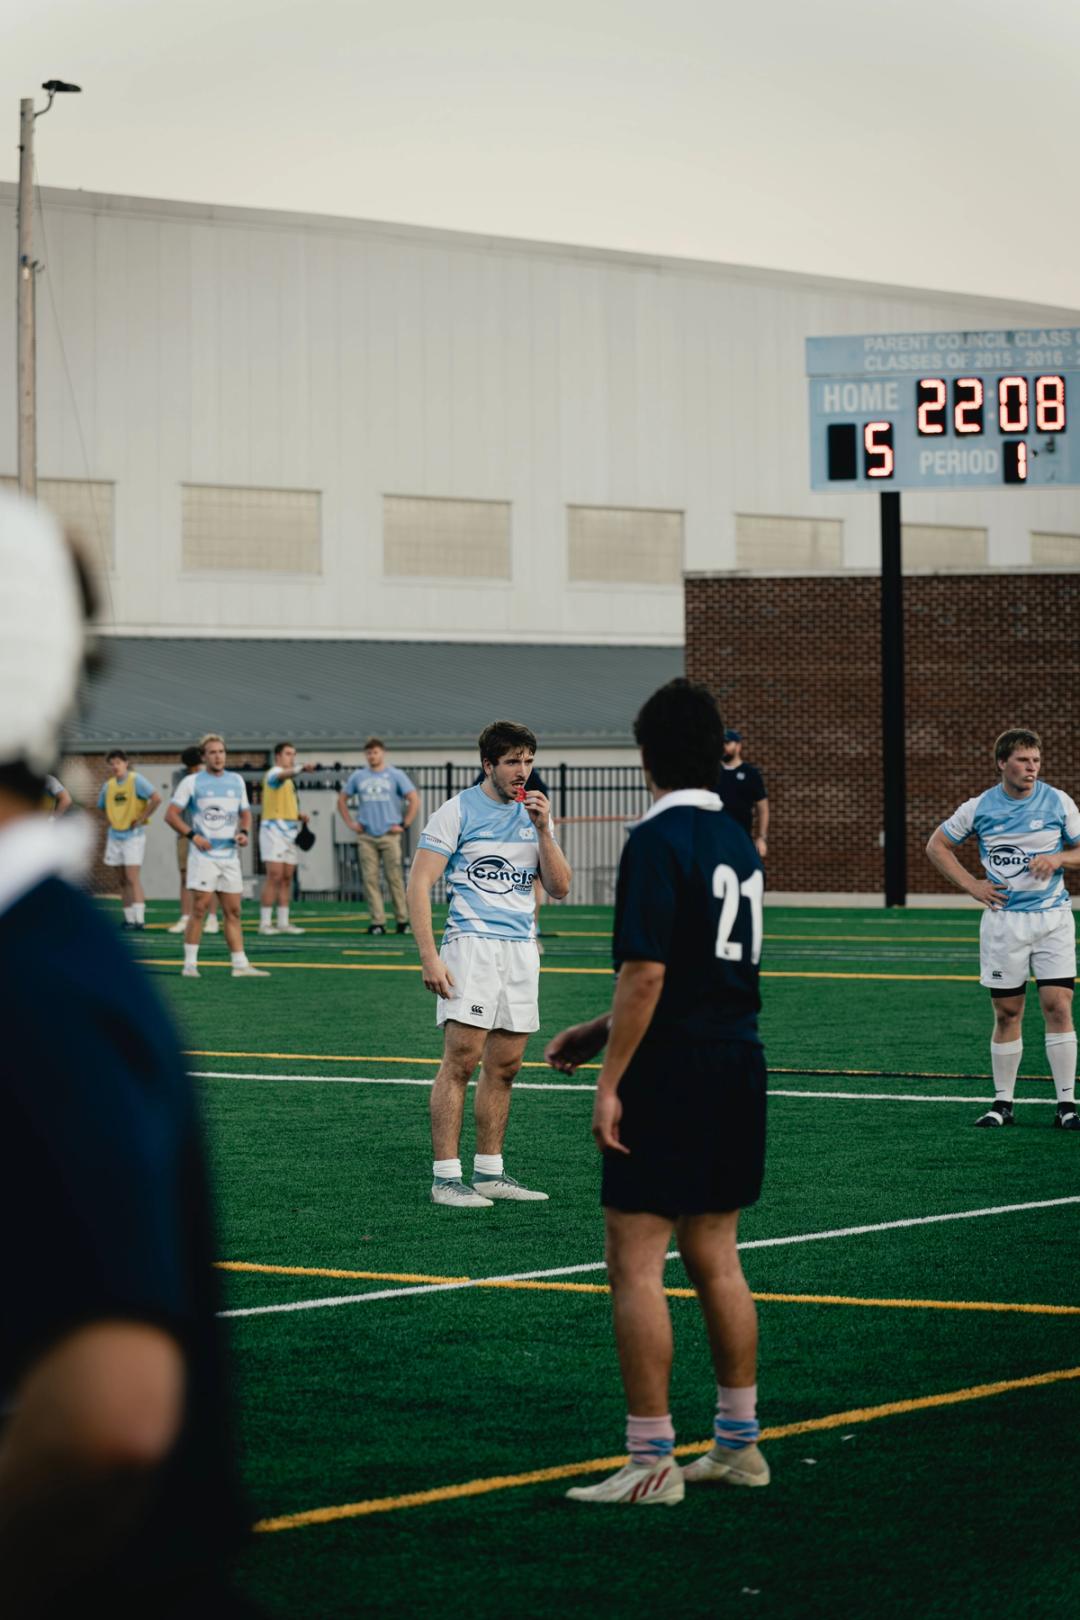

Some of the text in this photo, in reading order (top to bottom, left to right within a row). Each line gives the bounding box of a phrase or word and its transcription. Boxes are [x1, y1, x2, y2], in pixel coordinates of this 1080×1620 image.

[863, 335, 929, 352] PARENT
[935, 332, 1010, 350] COUNCIL
[1014, 329, 1072, 348] CLASS
[863, 353, 943, 371] CLASSES
[946, 352, 971, 369] OF
[975, 351, 1012, 368] 2015
[1025, 350, 1063, 367] 2016
[822, 381, 899, 412] HOME
[863, 422, 894, 477] 5
[919, 448, 999, 474] PERIOD
[1017, 440, 1027, 479] 1
[473, 866, 536, 885] Concis
[712, 863, 764, 965] 21
